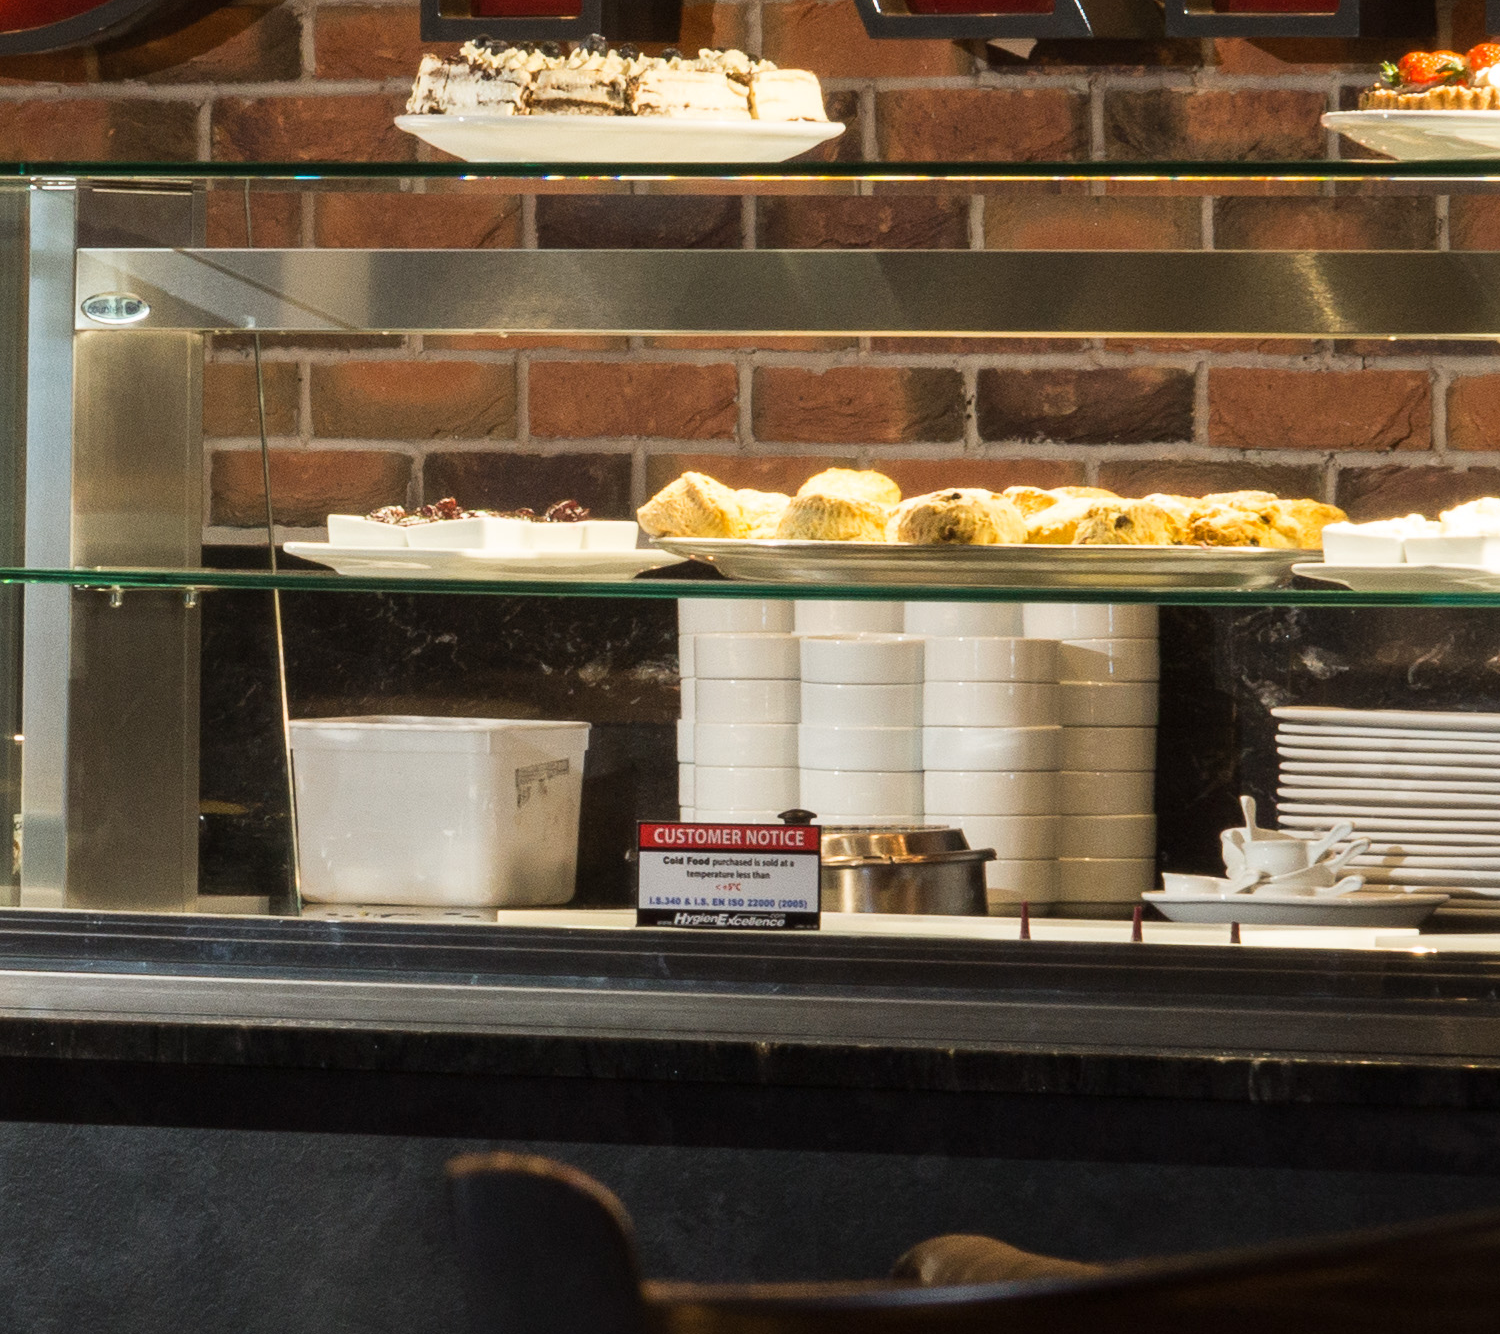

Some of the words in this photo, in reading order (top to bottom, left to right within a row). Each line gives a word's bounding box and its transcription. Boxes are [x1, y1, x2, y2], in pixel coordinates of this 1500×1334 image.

[653, 827, 742, 845] CUSTOMER
[746, 830, 805, 847] NOTICE
[663, 855, 684, 866] Cold
[687, 856, 710, 866] Food
[712, 857, 752, 868] purchased
[762, 858, 778, 867] sold
[779, 859, 788, 867] at
[686, 870, 734, 880] temperature
[735, 870, 751, 879] less
[752, 871, 771, 880] than
[712, 898, 725, 907] EN
[728, 898, 744, 907] ISO
[747, 898, 776, 908] 22000
[778, 899, 808, 909] (2005)
[674, 912, 786, 927] HygienExcellence
